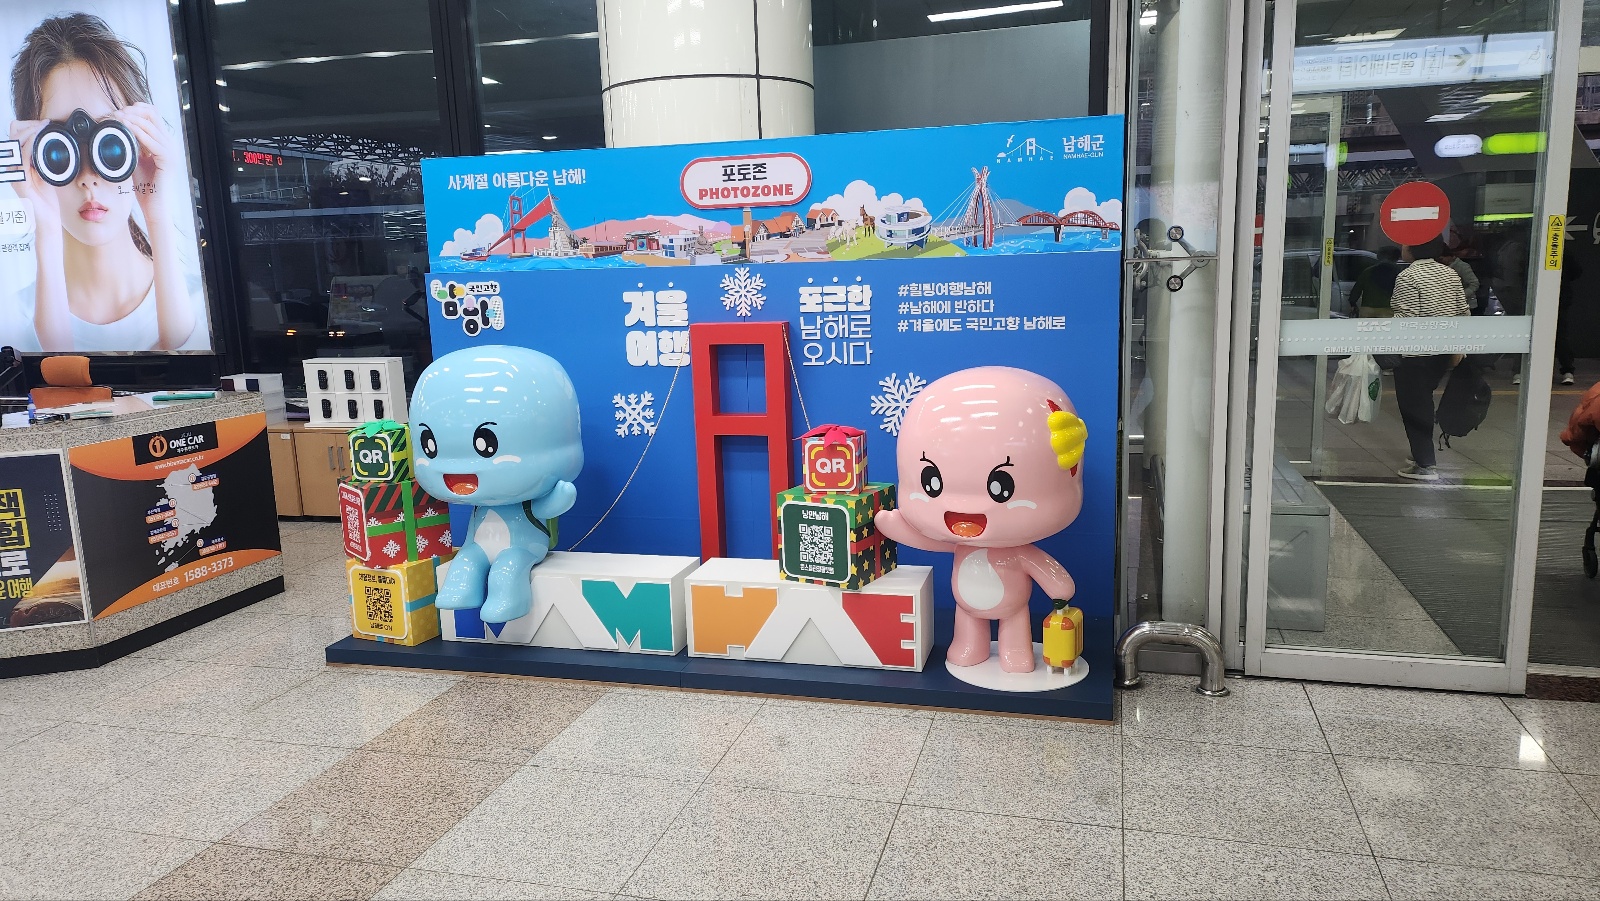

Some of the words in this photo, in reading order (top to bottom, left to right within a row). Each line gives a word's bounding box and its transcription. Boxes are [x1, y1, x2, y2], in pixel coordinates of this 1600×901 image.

[1062, 134, 1105, 153] 남해군
[447, 173, 489, 191] 사계절
[492, 169, 549, 189] 아름다운
[552, 168, 587, 186] 남해!
[721, 162, 768, 182] 포토존
[698, 183, 794, 201] PHOTOZONE
[468, 282, 498, 293] 국민고향
[897, 281, 992, 297] #힐링여행남해
[798, 284, 873, 313] 포근한
[897, 299, 951, 315] #남해에
[954, 299, 995, 314] 반하다
[622, 289, 690, 327] 겨울
[799, 314, 872, 340] 남해로
[897, 317, 963, 333] #겨울에도
[965, 316, 1020, 331] 국민고향
[1023, 315, 1066, 331] 남해로
[1399, 320, 1460, 331] 한국공항공사
[625, 329, 692, 367] 여행
[802, 341, 874, 366] 오시다
[1323, 345, 1361, 354] GIMHAE
[1363, 344, 1439, 353] INTERNATIONAL
[1443, 343, 1487, 352] AIRPORT
[169, 438, 187, 449] ONE
[187, 434, 204, 446] CAR
[358, 449, 384, 464] QR
[815, 457, 846, 474] QR
[0, 550, 31, 577] 로
[183, 556, 234, 582] 1588-3373
[7, 577, 33, 599] 여행
[152, 576, 180, 593] 대표번호
